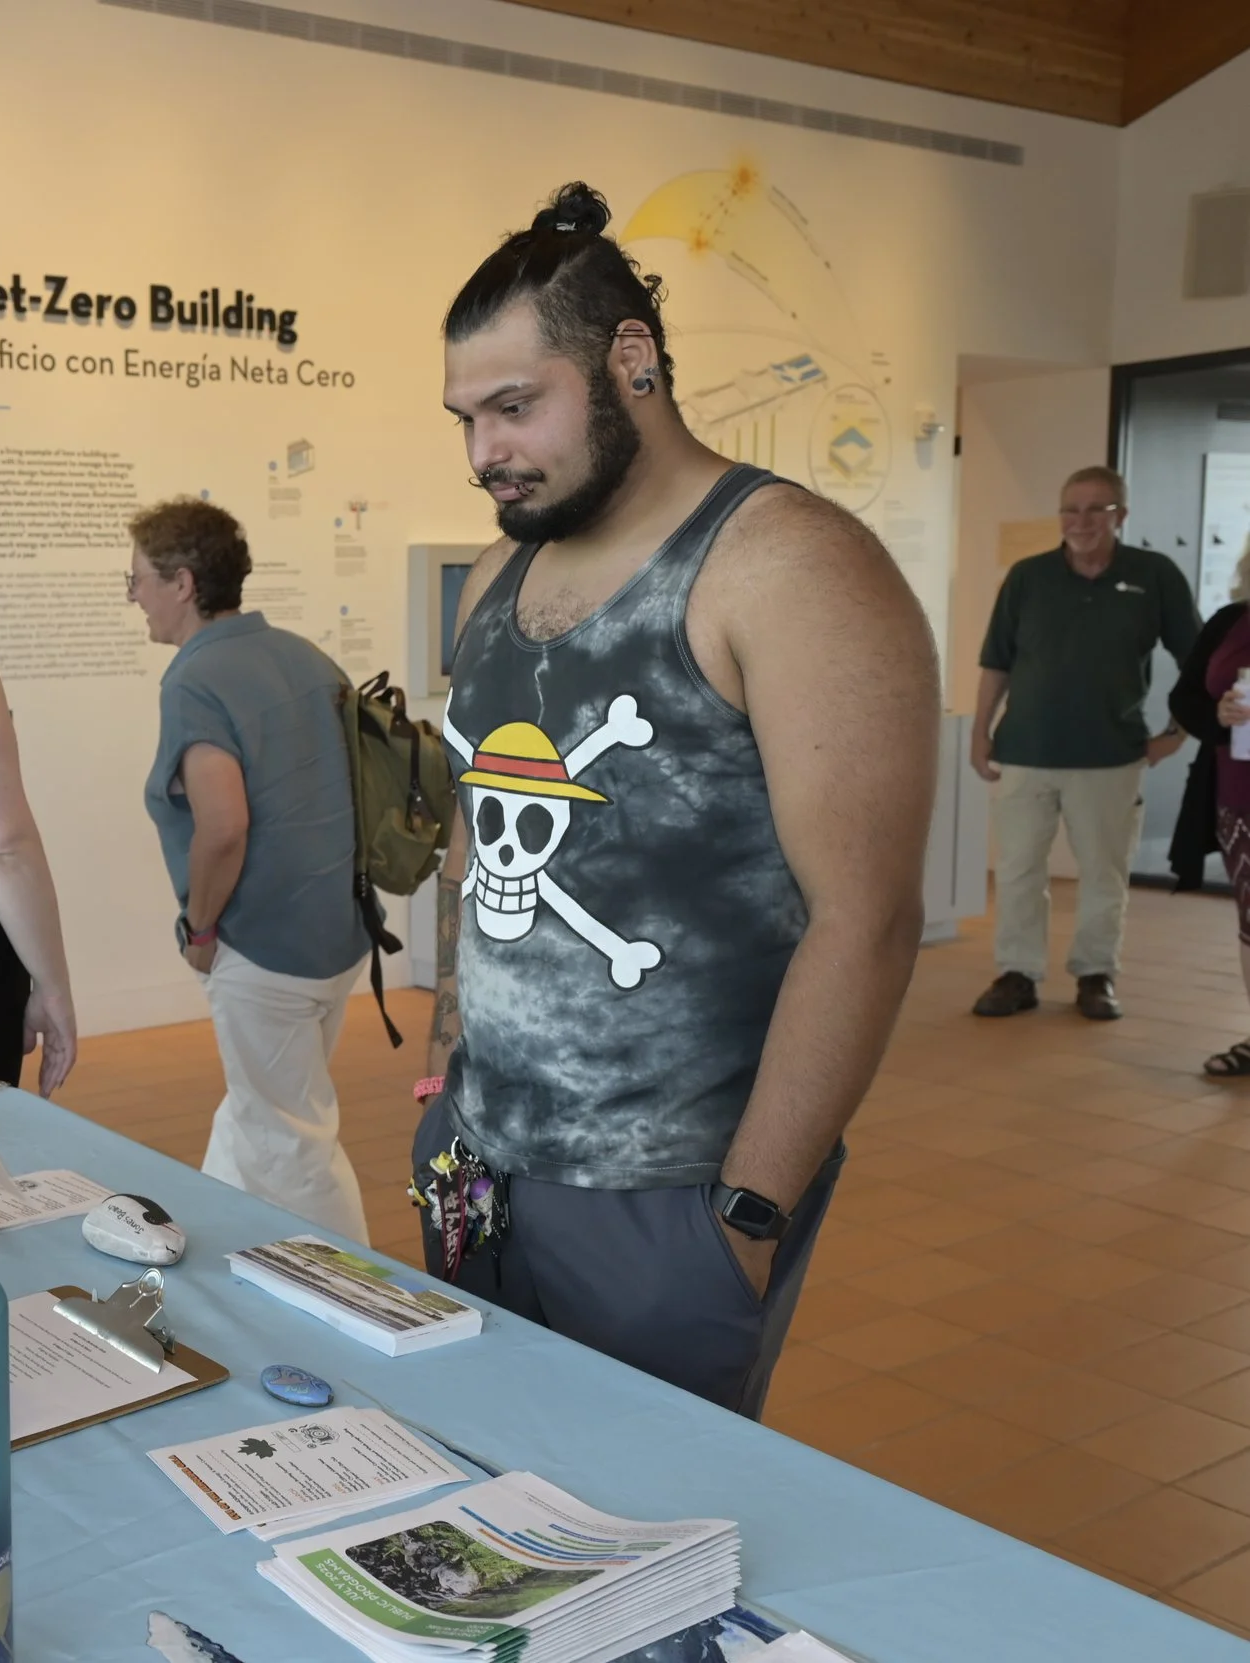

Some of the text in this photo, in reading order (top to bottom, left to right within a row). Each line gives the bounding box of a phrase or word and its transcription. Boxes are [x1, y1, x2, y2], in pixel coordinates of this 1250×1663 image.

[149, 284, 299, 345] Building
[66, 354, 114, 376] con
[124, 350, 221, 389] Energía
[230, 357, 289, 385] Neta
[297, 360, 356, 389] Cero
[125, 1215, 144, 1234] Jones
[316, 1563, 363, 1602] JULY 2025
[324, 1557, 416, 1622] PUBLIC PROGRAMS
